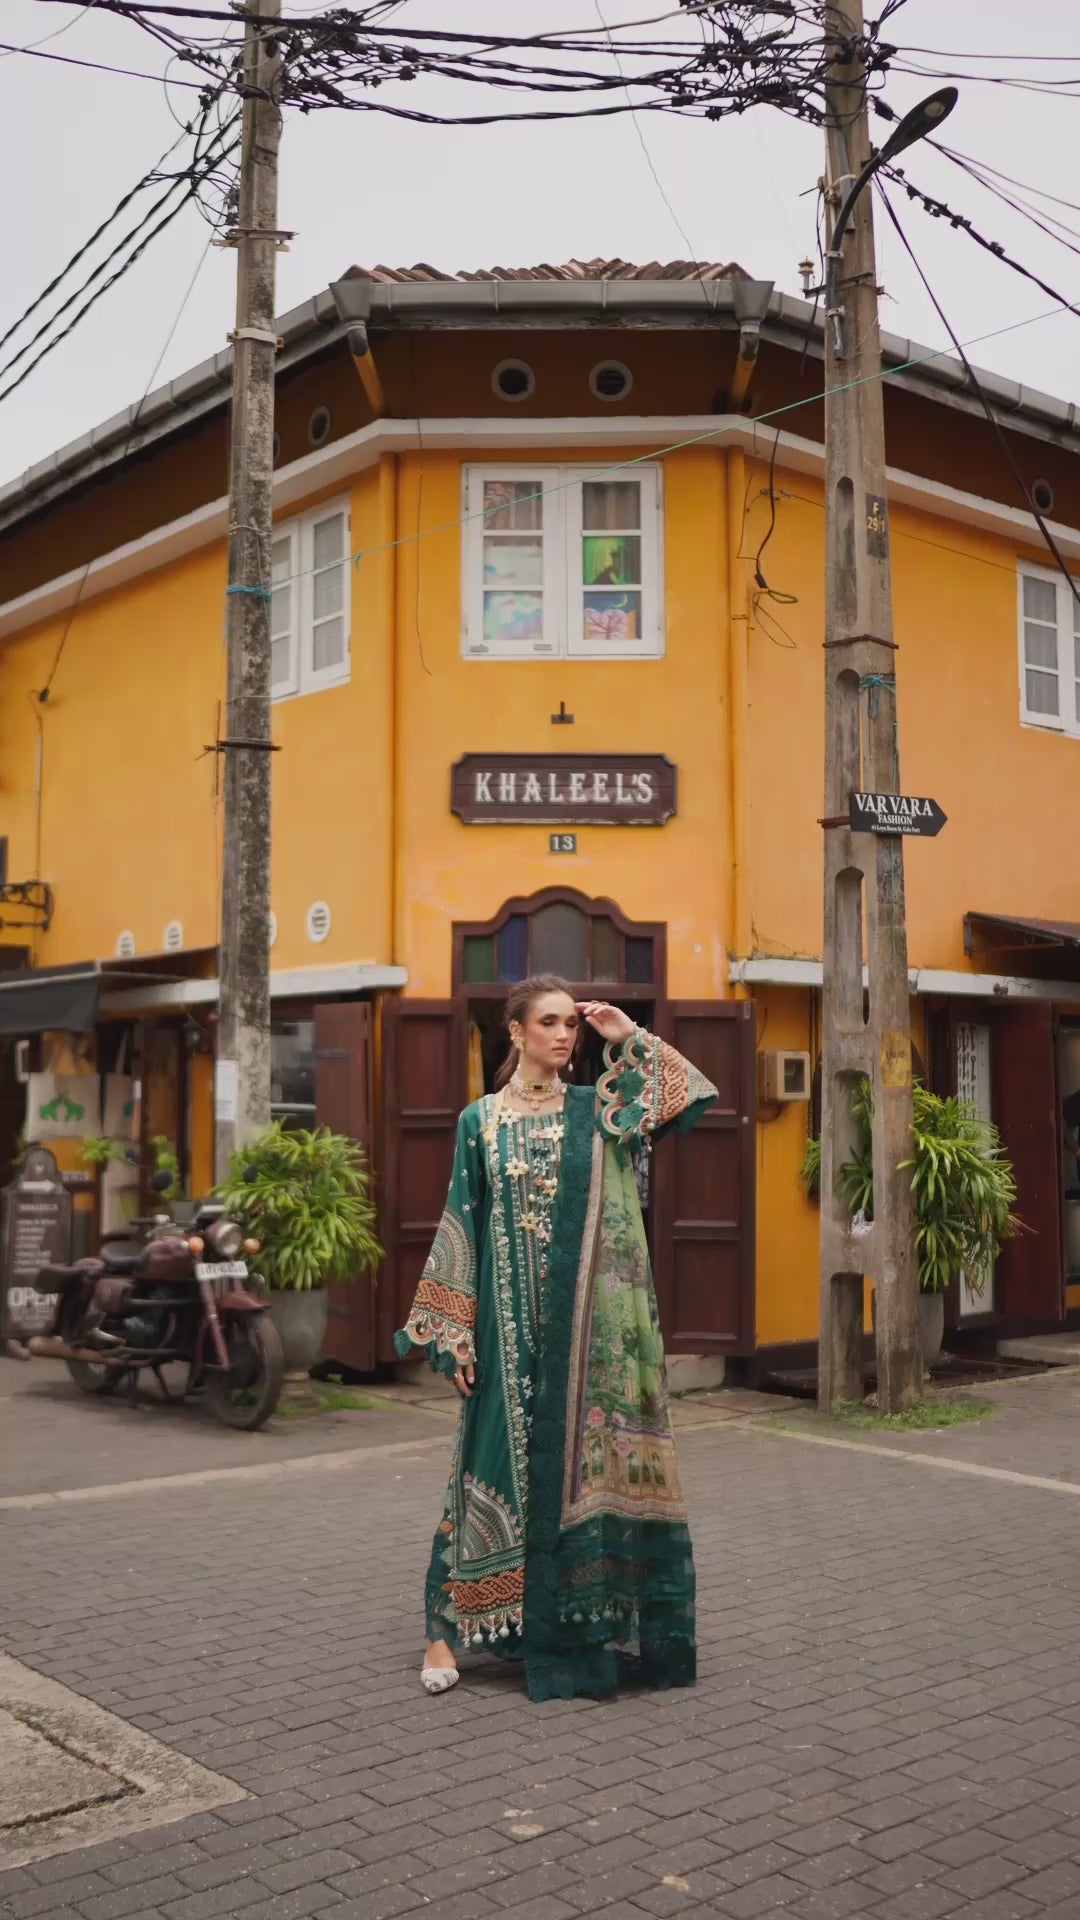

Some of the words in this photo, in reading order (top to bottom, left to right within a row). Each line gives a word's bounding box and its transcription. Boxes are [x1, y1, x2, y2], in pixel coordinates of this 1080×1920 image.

[475, 772, 654, 803] KHALEEL'S
[878, 814, 913, 825] FASHION
[552, 836, 574, 850] 13
